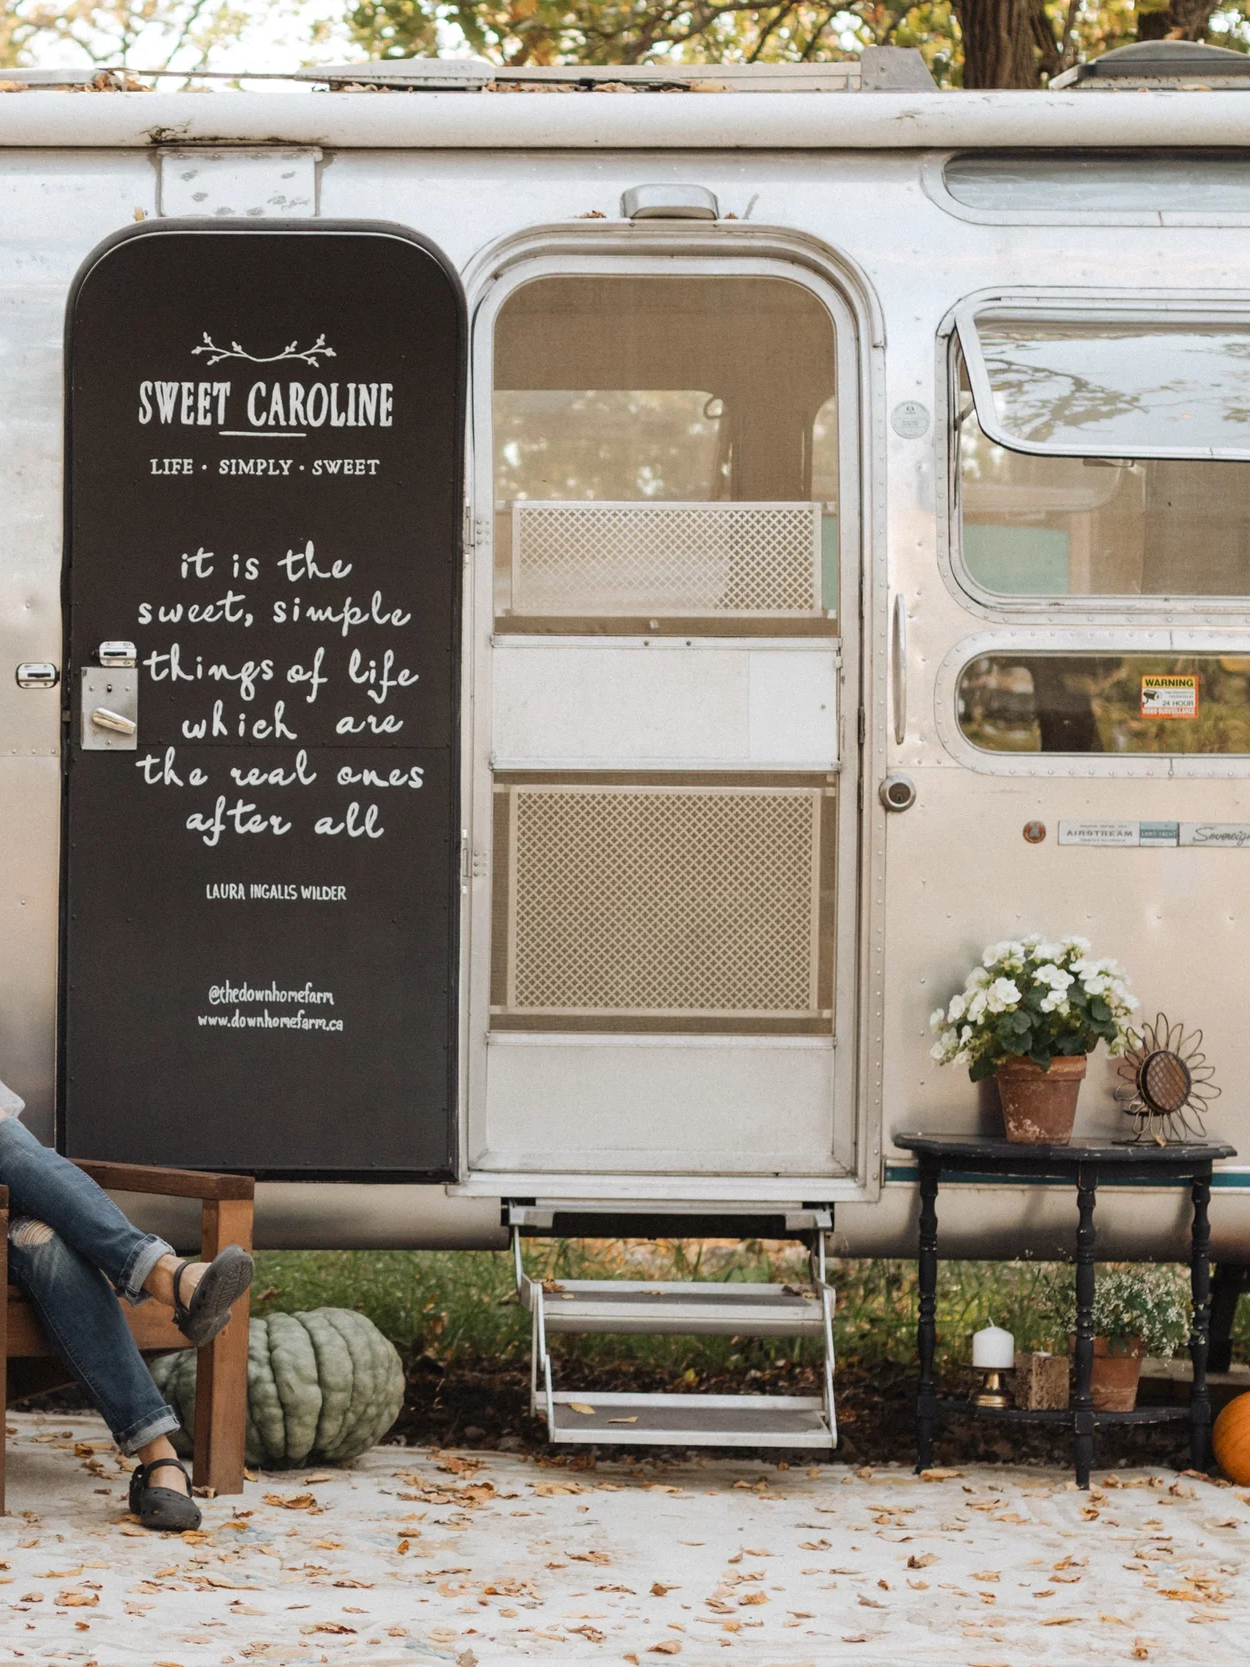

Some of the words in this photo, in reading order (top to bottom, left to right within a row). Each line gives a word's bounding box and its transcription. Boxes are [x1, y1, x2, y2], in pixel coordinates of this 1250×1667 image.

[138, 380, 232, 425] SWEET
[247, 381, 394, 428] CAROLINE
[150, 459, 194, 475] LIFE
[219, 459, 294, 475] SIMPLY
[312, 459, 381, 475] SWEET
[180, 546, 215, 579] it
[232, 553, 260, 581] is
[276, 540, 353, 582] the
[137, 590, 254, 628] sweet,
[272, 591, 412, 638] simple
[142, 643, 274, 701] things
[286, 647, 328, 703] of
[348, 649, 419, 704] life
[1145, 678, 1193, 687] WARNING
[181, 700, 298, 740] which
[335, 714, 404, 735] are
[135, 746, 209, 787] the
[230, 749, 318, 787] real
[337, 766, 425, 789] ones
[185, 794, 292, 847] after
[313, 801, 385, 839] all
[205, 883, 246, 901] LAURA
[249, 884, 298, 901] INGALLS
[300, 885, 347, 901] WILDER
[208, 980, 335, 1006] @thedownhomefarm
[197, 1009, 344, 1031] www.downhomefarm.ca
